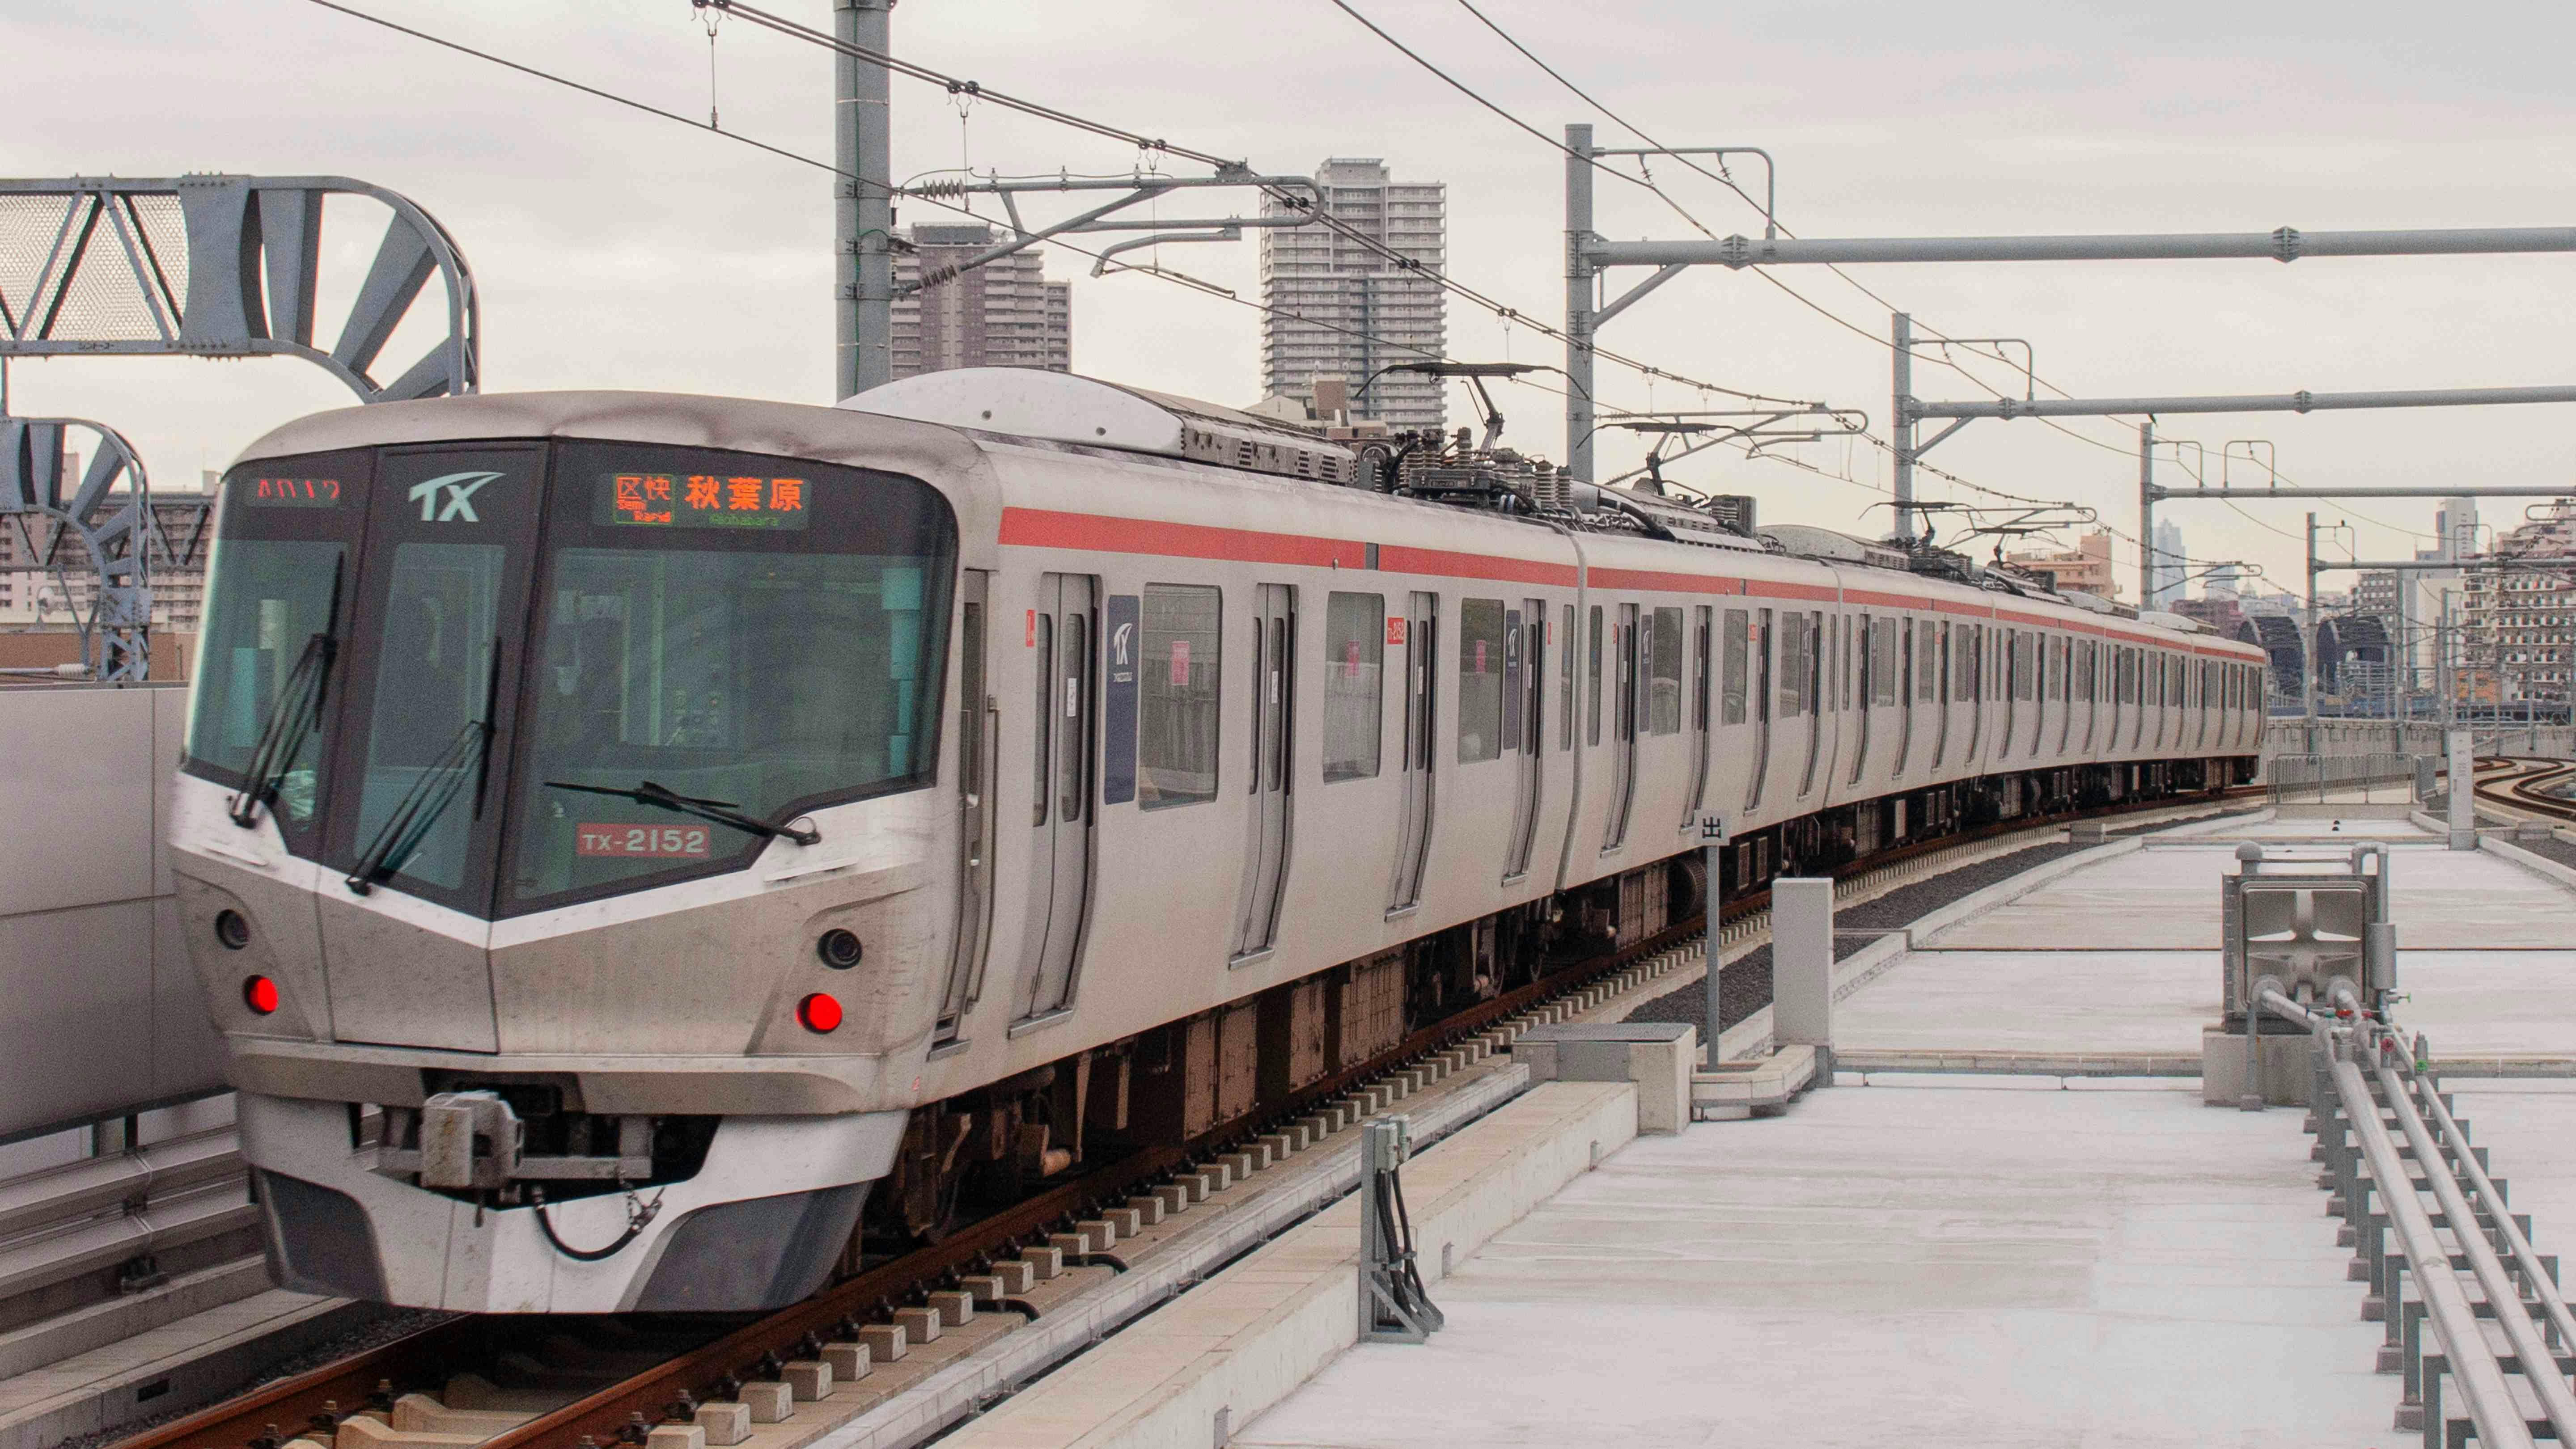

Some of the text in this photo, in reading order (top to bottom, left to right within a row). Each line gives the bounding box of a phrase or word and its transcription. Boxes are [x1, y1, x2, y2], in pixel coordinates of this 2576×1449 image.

[408, 471, 507, 522] TX
[616, 476, 670, 501] 区快
[684, 475, 804, 511] 秋葉原
[1702, 816, 1721, 839] 出
[582, 829, 705, 853] TX-2152
